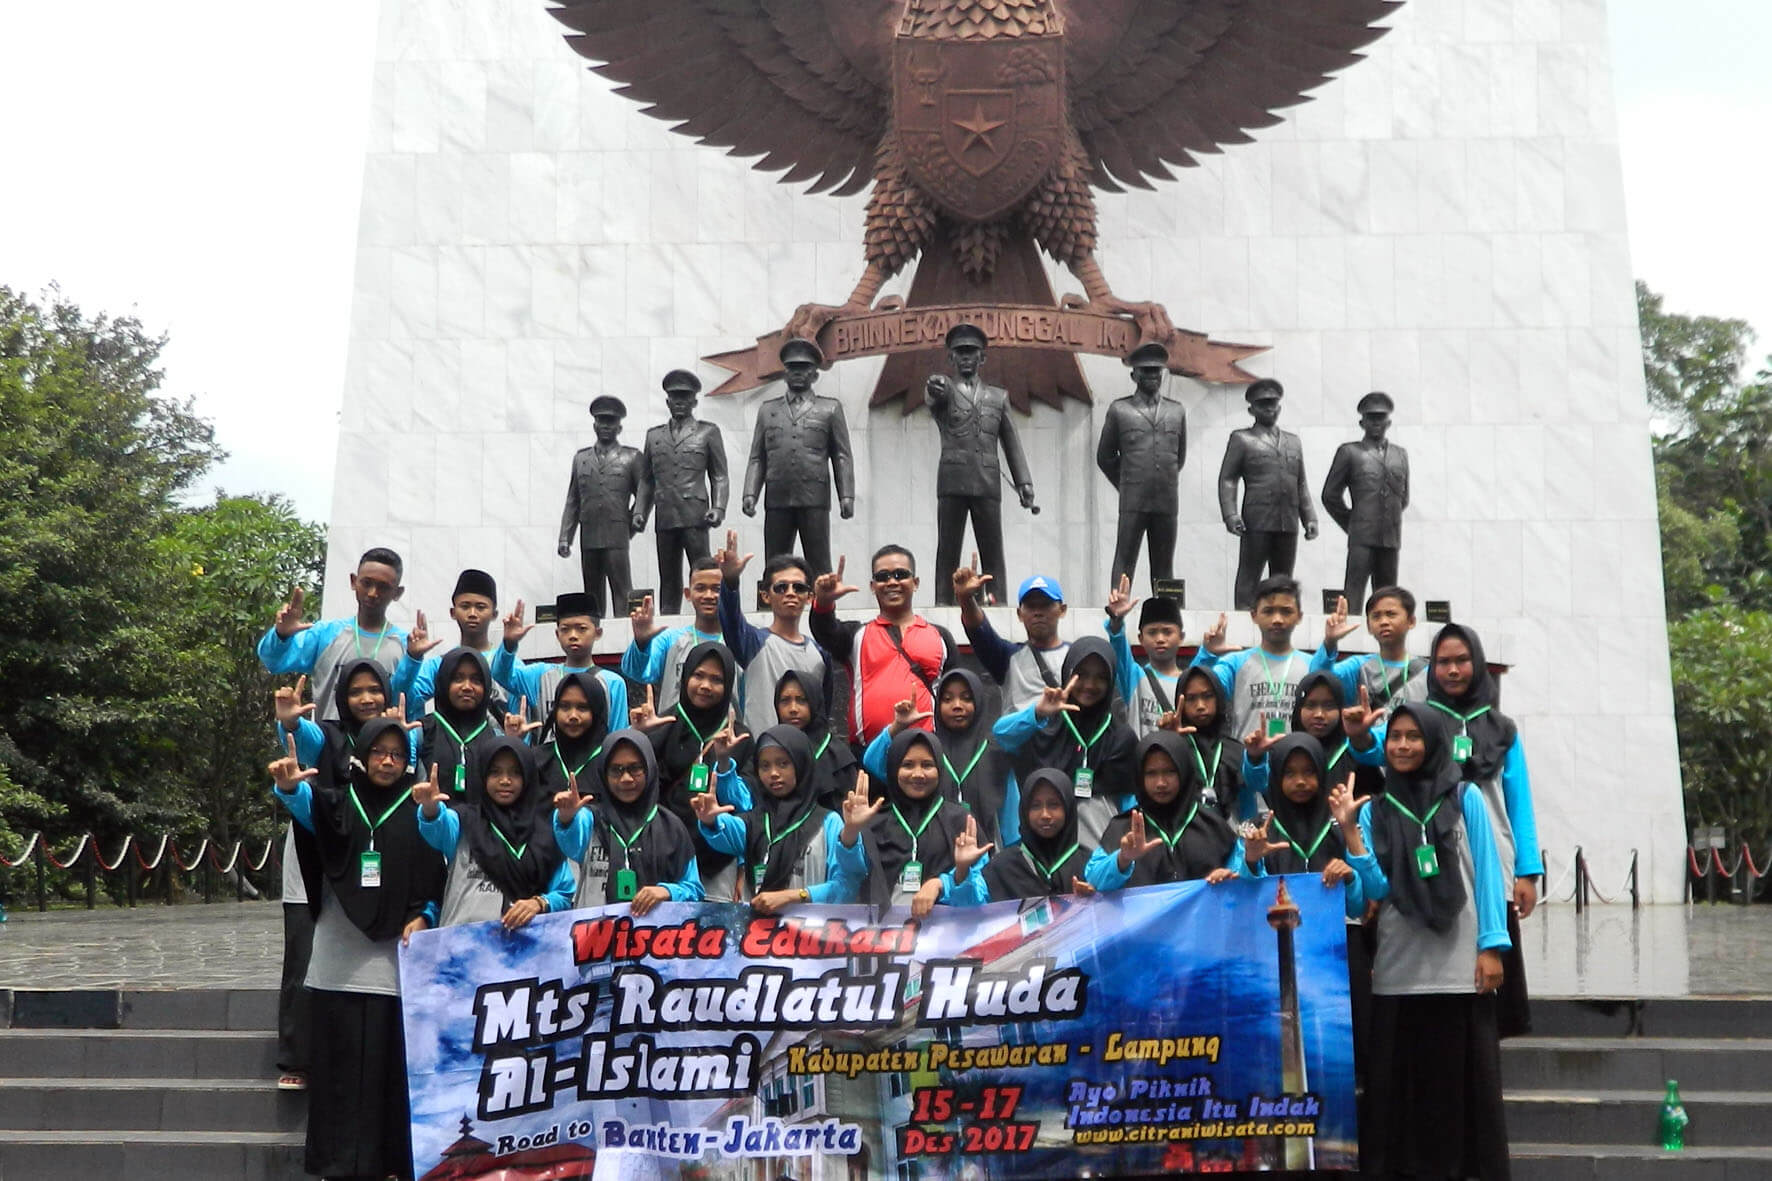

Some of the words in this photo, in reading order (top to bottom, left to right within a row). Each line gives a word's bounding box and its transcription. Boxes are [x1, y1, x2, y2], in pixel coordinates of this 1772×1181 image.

[835, 312, 948, 354] BHINNEKA
[1097, 319, 1130, 352] IKA
[572, 918, 727, 963] Wisata
[742, 917, 919, 957] Edukasi
[480, 984, 591, 1046] Mts
[617, 971, 900, 1026] Raudlatul
[924, 964, 1081, 1020] Huda
[789, 1045, 920, 1077] Kabupaten
[930, 1043, 1069, 1072] Pesawaran
[1103, 1033, 1221, 1065] Lampung
[485, 1039, 755, 1114] Al-Islami
[1068, 1080, 1118, 1108] Ayo
[1129, 1076, 1212, 1100] Piknik
[1067, 1102, 1193, 1126] Indonesia
[1202, 1098, 1238, 1119] Itu
[1249, 1096, 1321, 1117] Indah
[496, 1125, 558, 1156] Road
[567, 1120, 592, 1140] to
[602, 1119, 859, 1155] Banten-Jakarta
[903, 1128, 955, 1155] Des
[964, 1124, 1037, 1152] 2017
[1075, 1121, 1317, 1144] www.citraniwisata.com
